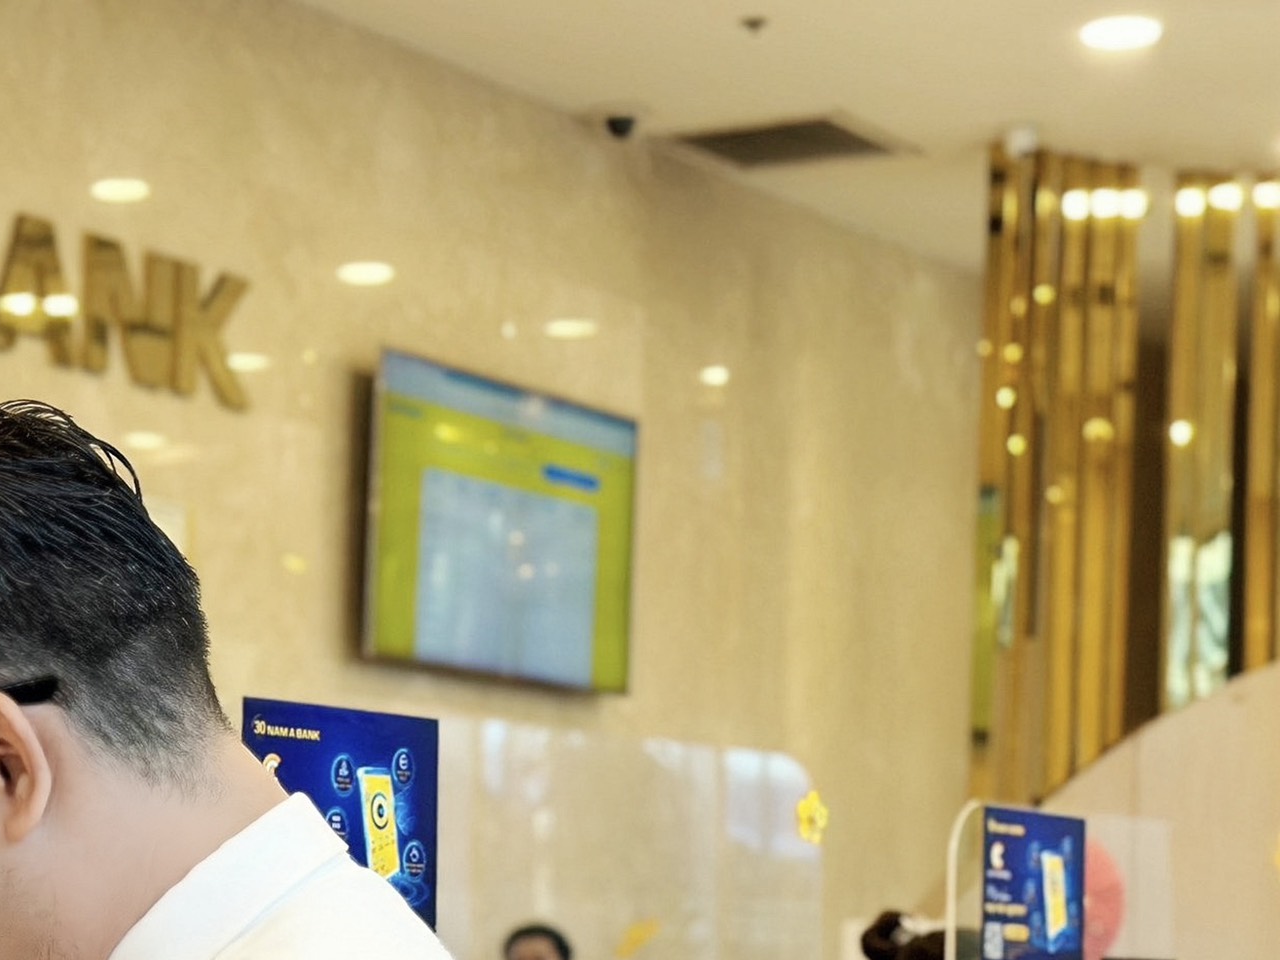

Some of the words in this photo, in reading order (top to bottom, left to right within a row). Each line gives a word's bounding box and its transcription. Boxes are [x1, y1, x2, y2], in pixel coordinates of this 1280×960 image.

[253, 720, 266, 735] 30
[267, 725, 288, 737] NAM
[289, 728, 295, 737] A
[296, 728, 320, 741] BANK
